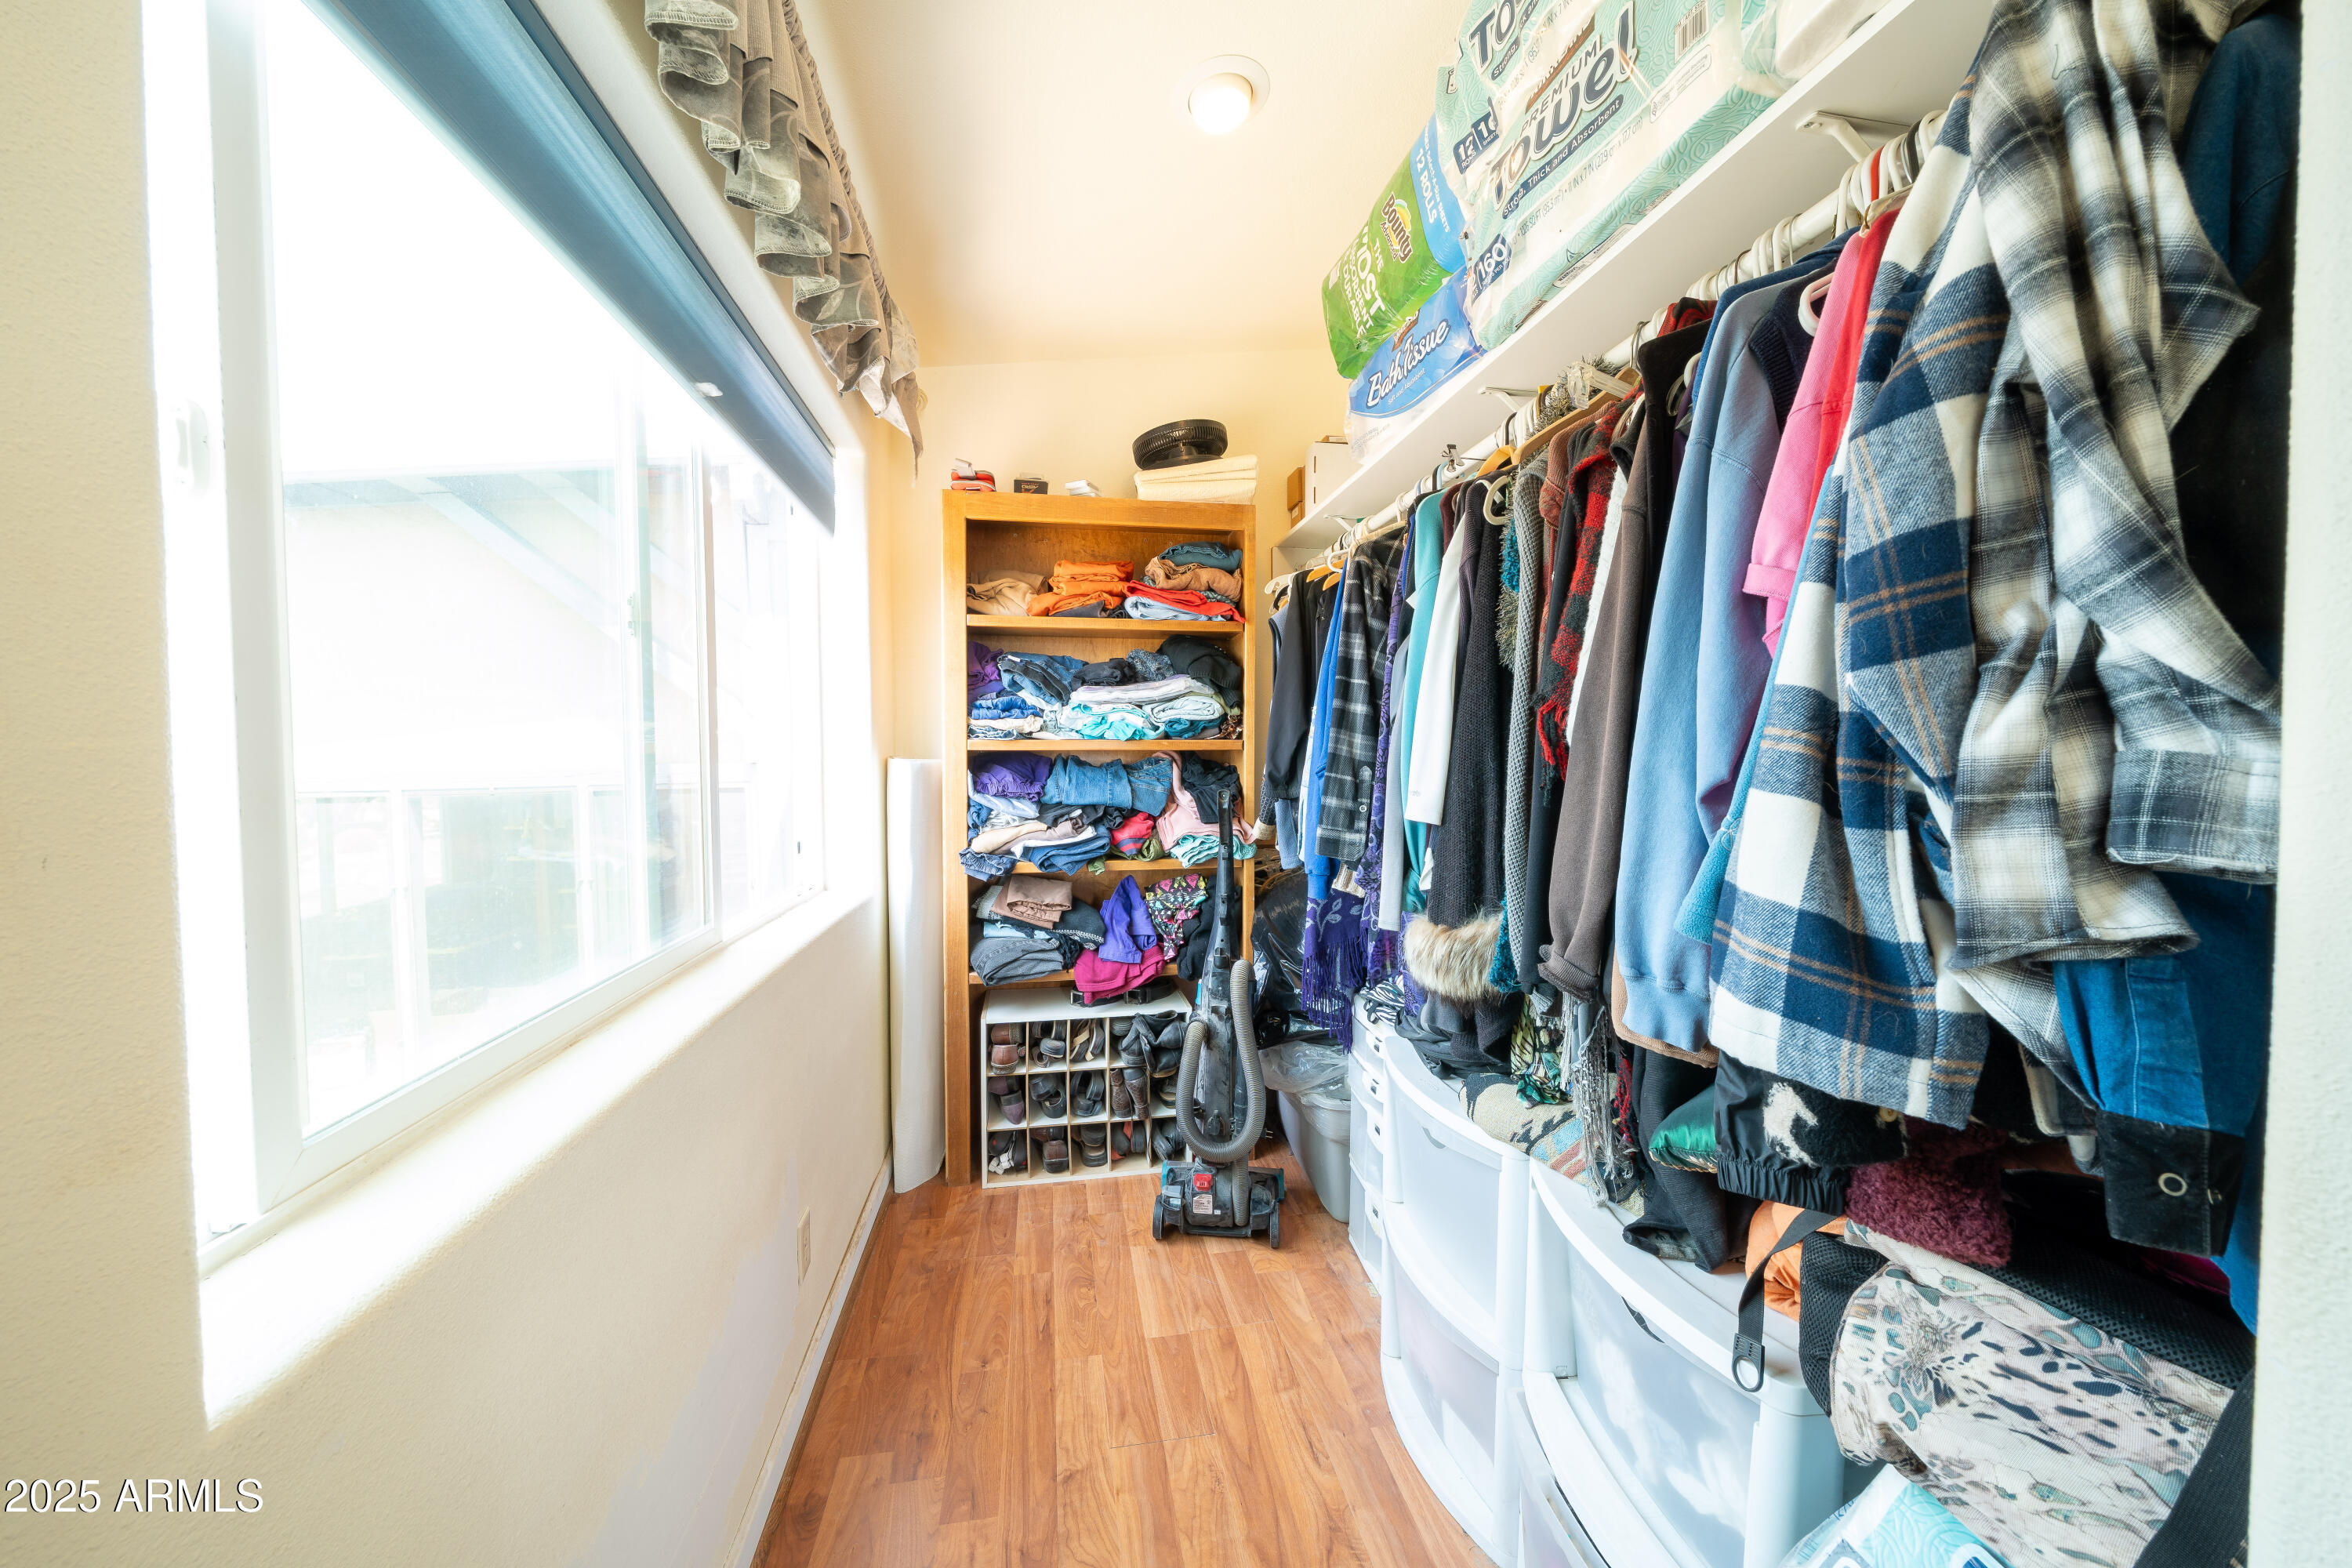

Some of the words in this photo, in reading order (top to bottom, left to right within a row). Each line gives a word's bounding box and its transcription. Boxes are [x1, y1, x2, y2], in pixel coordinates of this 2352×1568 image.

[1491, 8, 1631, 205] Towel
[1520, 42, 1598, 135] PREMIUM
[1416, 147, 1425, 173] 12
[1458, 136, 1474, 161] 12
[1527, 163, 1551, 187] Thick
[1552, 146, 1569, 166] and
[1570, 100, 1620, 151] Absorbent
[1420, 169, 1438, 224] ROLLS
[1374, 238, 1385, 273] THE
[1380, 221, 1399, 260] Advanced
[1381, 193, 1413, 263] Bounty
[1478, 242, 1506, 279] 160
[1367, 351, 1404, 408] Bath
[1403, 320, 1450, 377] Tissue
